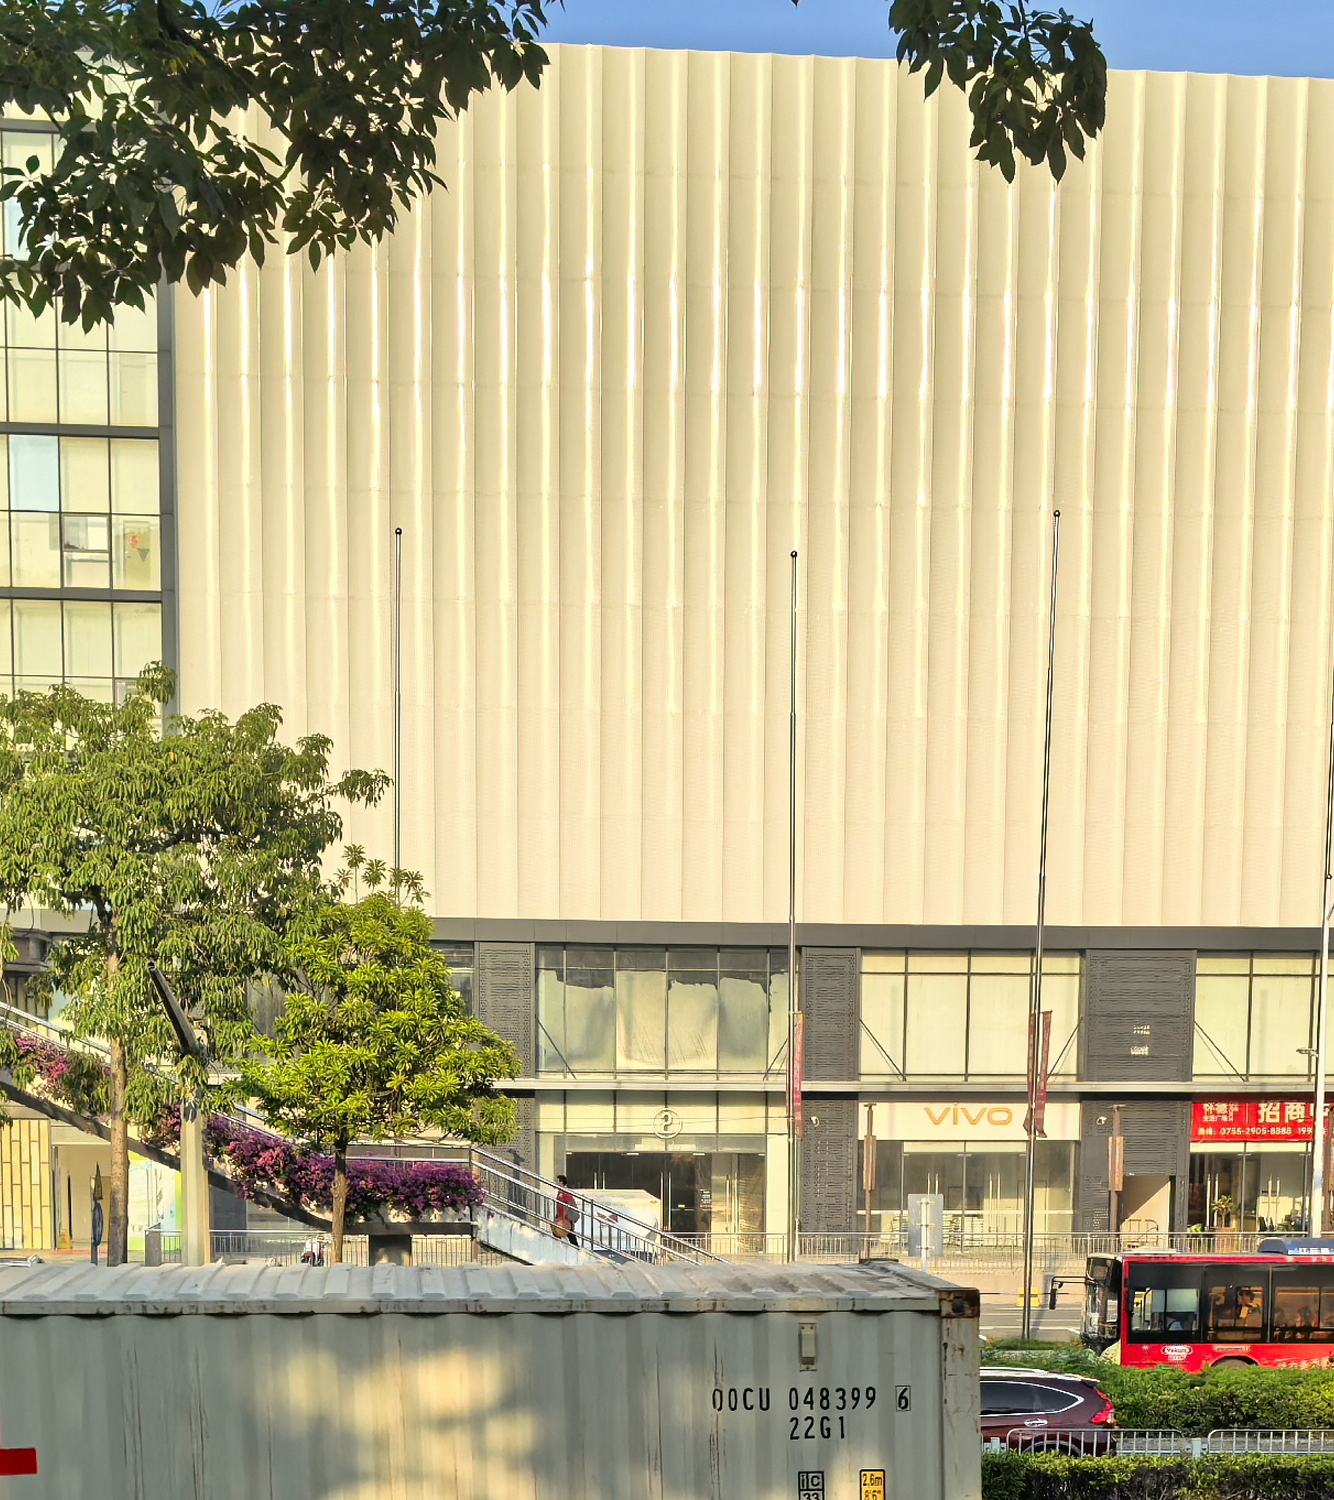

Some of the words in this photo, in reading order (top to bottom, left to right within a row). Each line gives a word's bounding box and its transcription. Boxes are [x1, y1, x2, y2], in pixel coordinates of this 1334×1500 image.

[788, 1386, 877, 1411] 048399
[896, 1386, 910, 1410] 6
[790, 1415, 847, 1440] 22G1
[862, 1474, 883, 1487] 2.6m
